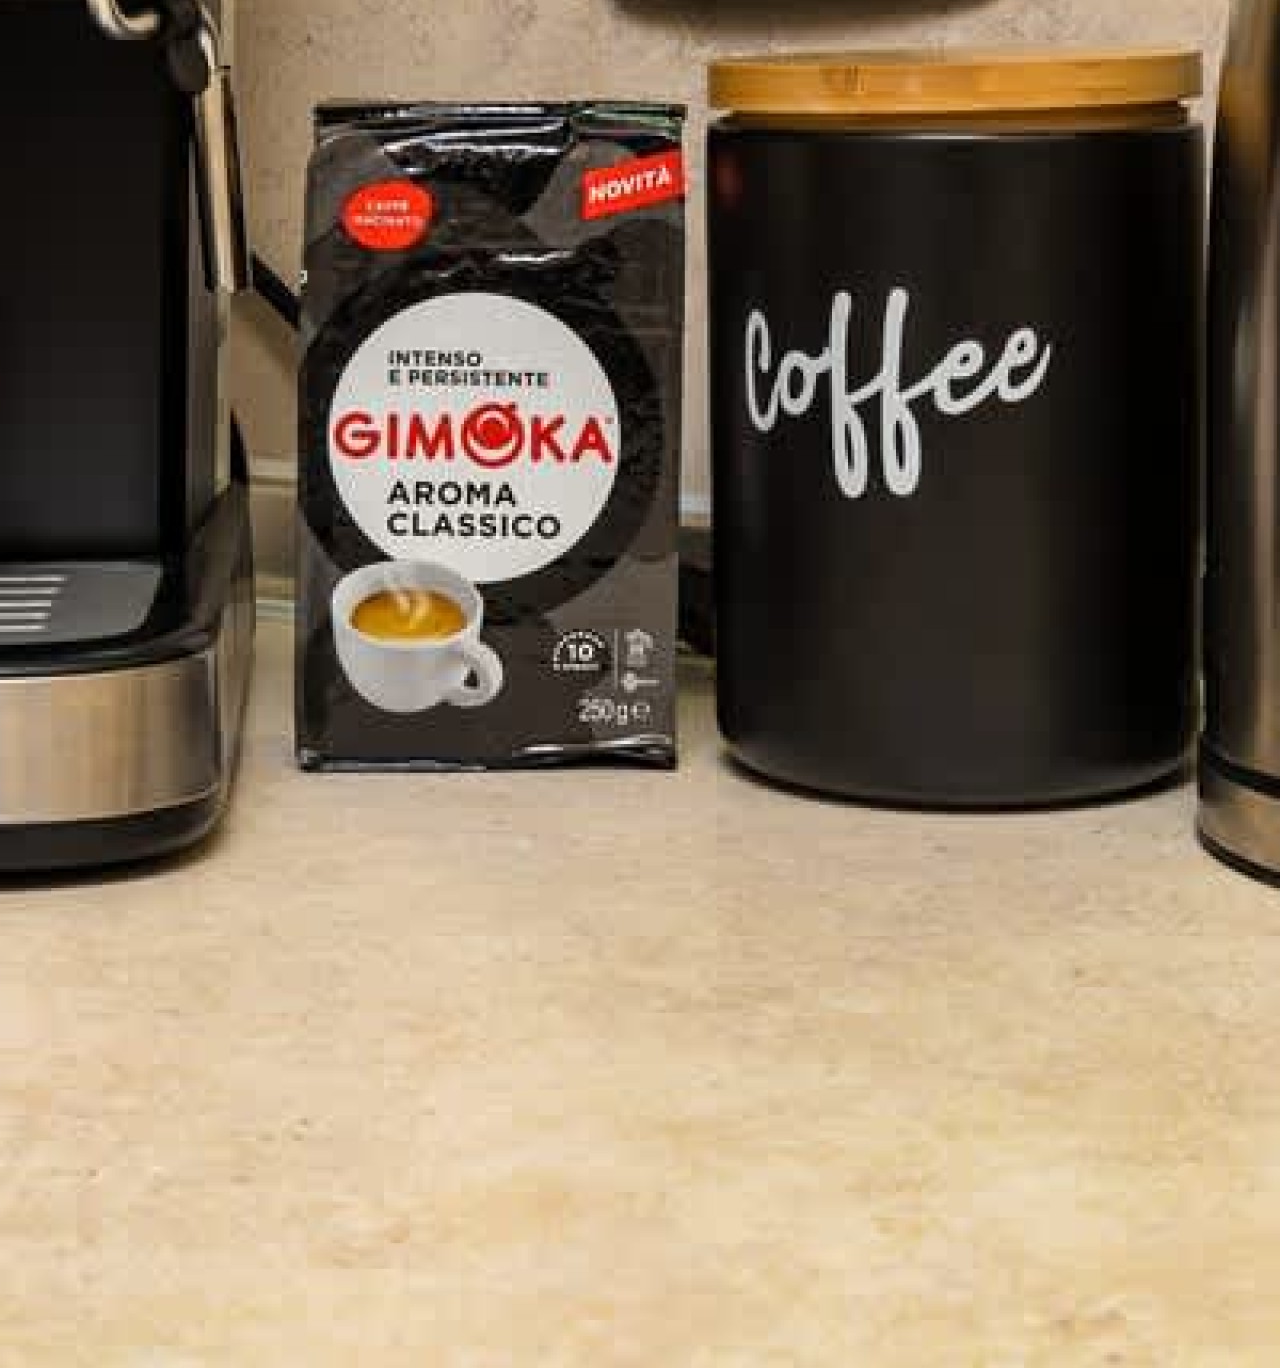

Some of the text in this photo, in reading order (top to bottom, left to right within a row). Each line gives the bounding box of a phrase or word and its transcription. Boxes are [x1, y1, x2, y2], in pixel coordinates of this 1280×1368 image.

[387, 349, 483, 368] INTENSO
[389, 369, 549, 388] E PERSISTENTE
[744, 286, 1052, 500] Coffee
[332, 401, 614, 470] GIMOKA
[386, 480, 517, 508] AROMA
[386, 512, 561, 539] CLASSICO
[568, 643, 595, 661] 10
